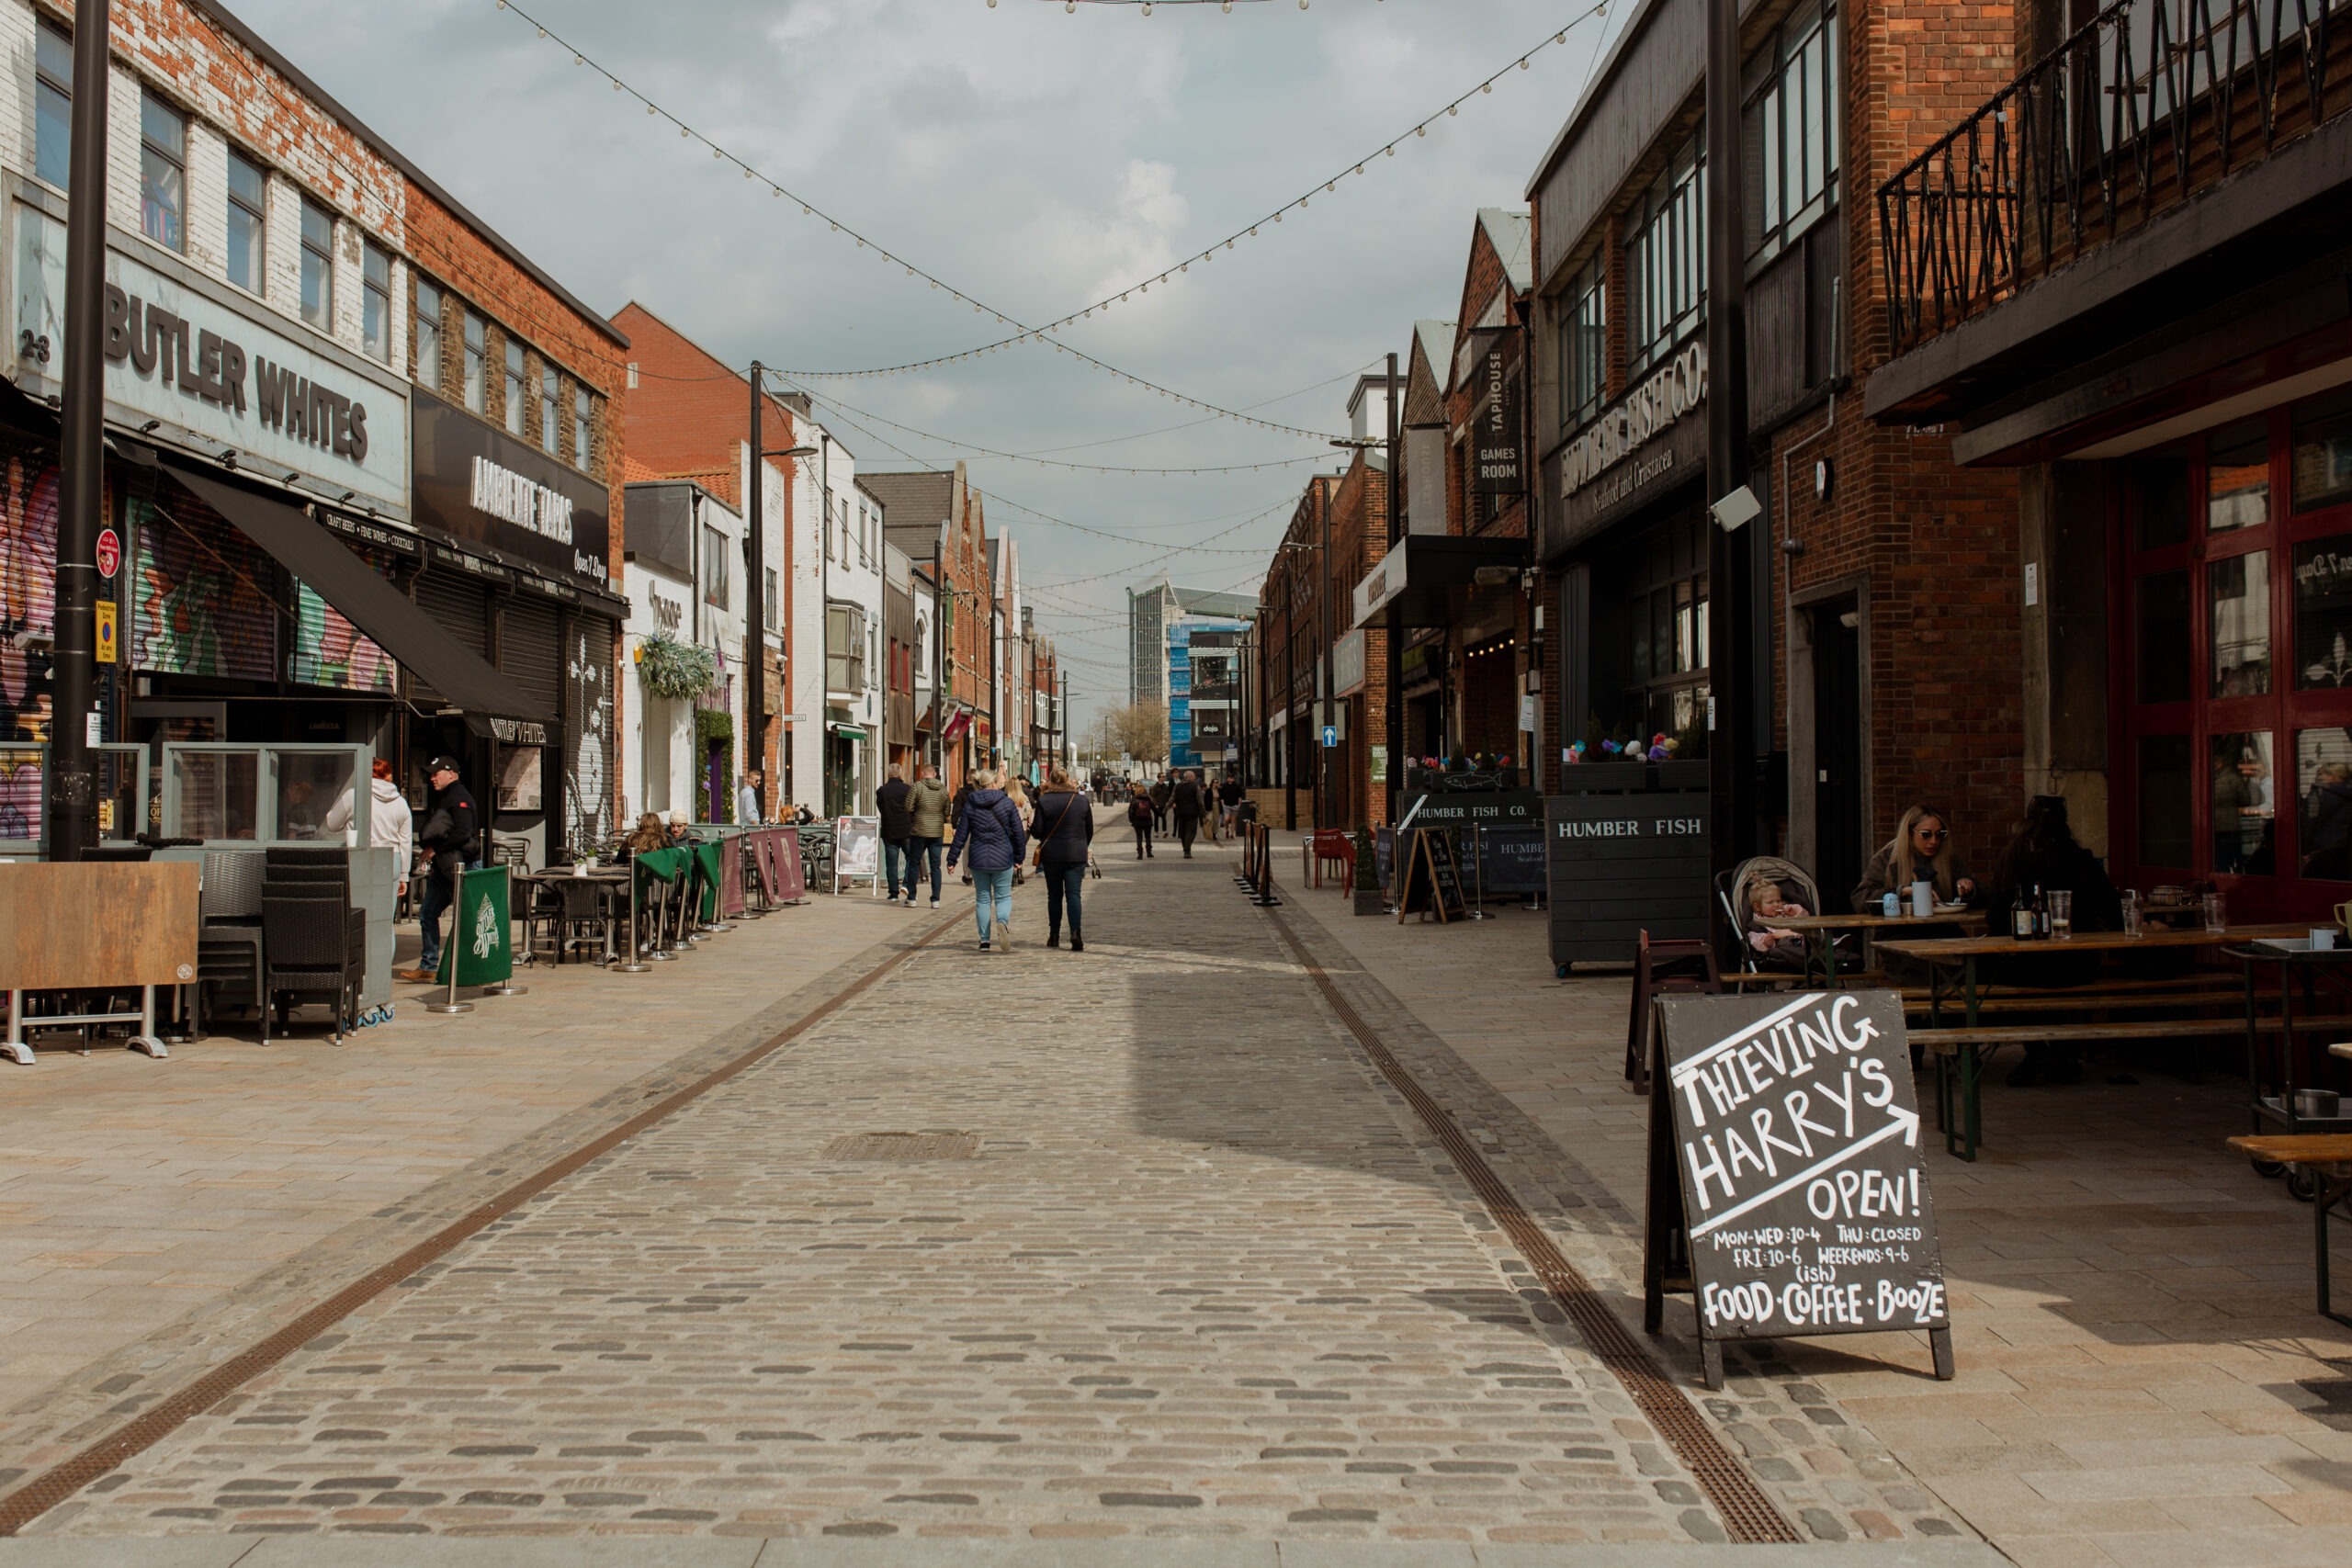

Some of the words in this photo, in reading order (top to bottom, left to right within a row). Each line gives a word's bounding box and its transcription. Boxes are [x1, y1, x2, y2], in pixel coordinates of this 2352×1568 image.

[106, 282, 247, 412] BUTLER
[256, 355, 368, 459] WHITES
[1490, 353, 1503, 432] TAPHOUSE
[1561, 407, 1630, 499] HUMBER
[1626, 367, 1675, 450] FISH
[1671, 342, 1709, 418] CO.
[1481, 447, 1515, 460] GAMES
[1481, 464, 1516, 479] ROOM
[470, 456, 537, 533] AMBIENTE
[537, 485, 572, 546] TAPAS
[1593, 476, 1620, 513] Seafood
[1620, 465, 1633, 496] and
[1634, 449, 1673, 488] Crustacea
[326, 513, 342, 529] CRAFT
[342, 519, 356, 533] BEERS
[360, 525, 372, 539] FINE
[372, 529, 387, 543] WINES
[390, 535, 414, 551] COCKTAILS
[574, 547, 588, 574] Open
[588, 554, 593, 576] 7
[1418, 807, 1464, 818] HUMBER
[1473, 807, 1498, 818] FISH
[1510, 806, 1527, 816] CO.
[1558, 820, 1639, 837] HUMBER
[1656, 818, 1702, 835] FISH
[1500, 843, 1544, 854] HUMBE
[1674, 995, 1879, 1127] THIEVING
[1685, 1056, 1894, 1210] HARRY'S
[1806, 1168, 1920, 1220] OPEN!
[1795, 1265, 1836, 1283] (ish)
[1703, 1281, 1773, 1326] FOOD
